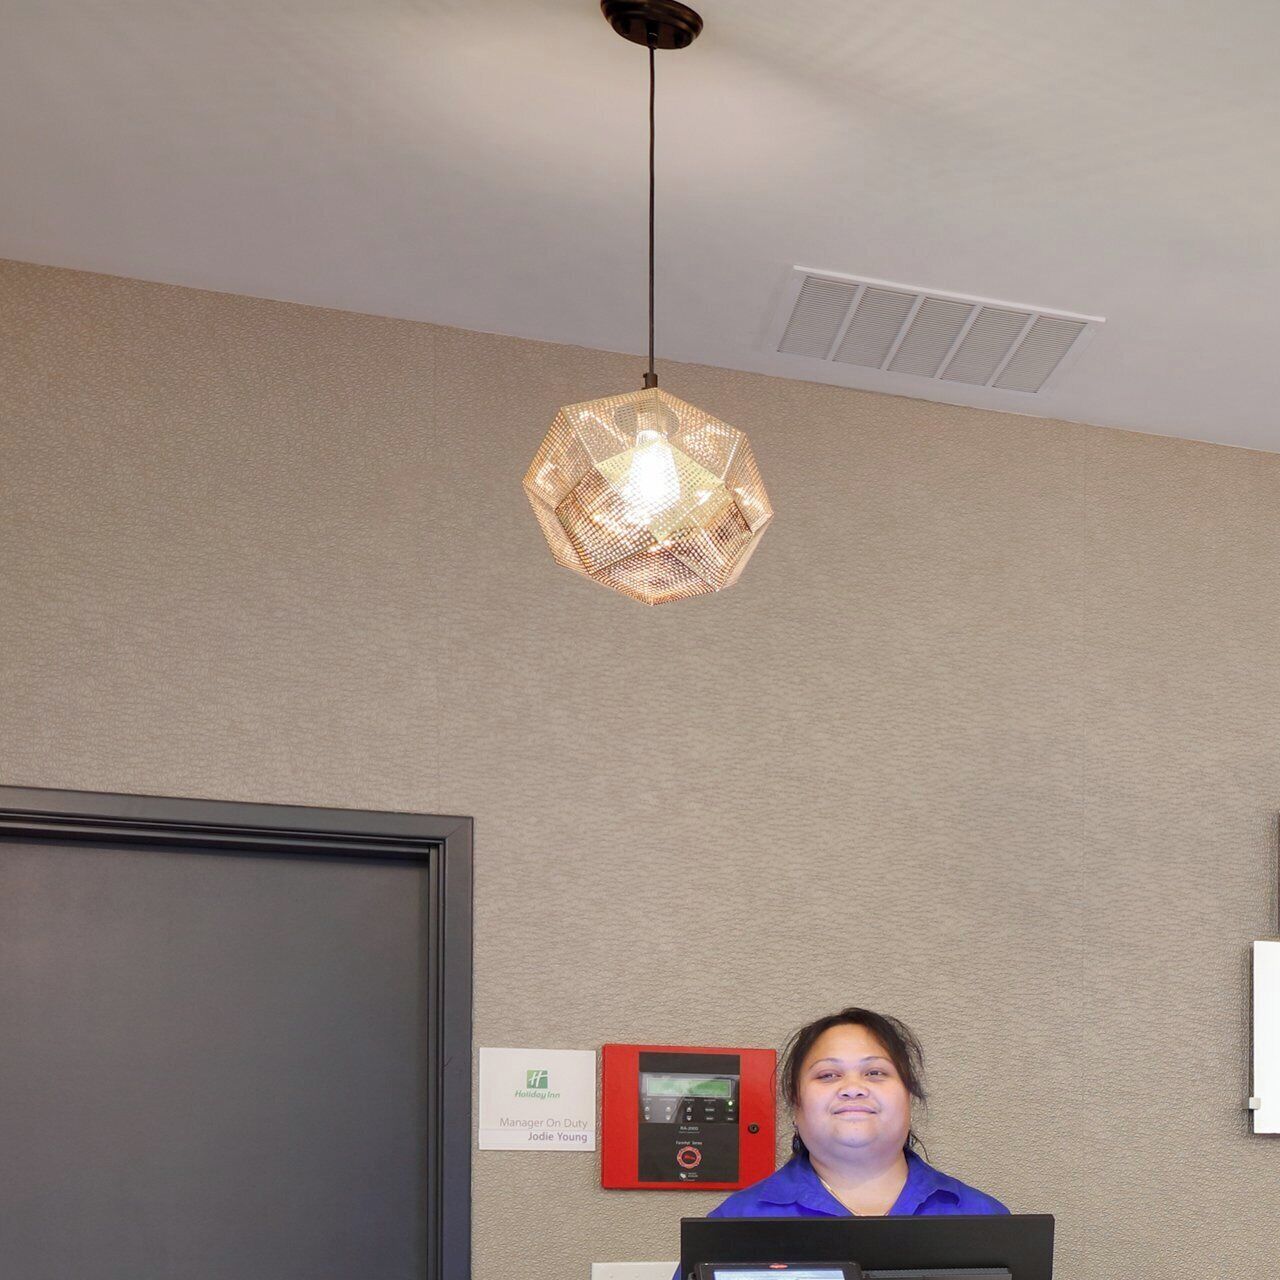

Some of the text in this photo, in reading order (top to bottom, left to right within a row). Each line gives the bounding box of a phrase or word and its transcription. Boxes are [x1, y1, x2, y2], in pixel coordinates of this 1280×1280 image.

[514, 1089, 561, 1100] Holiday Inn
[499, 1117, 588, 1129] Manager On Duty
[528, 1131, 588, 1143] Jodie Young
